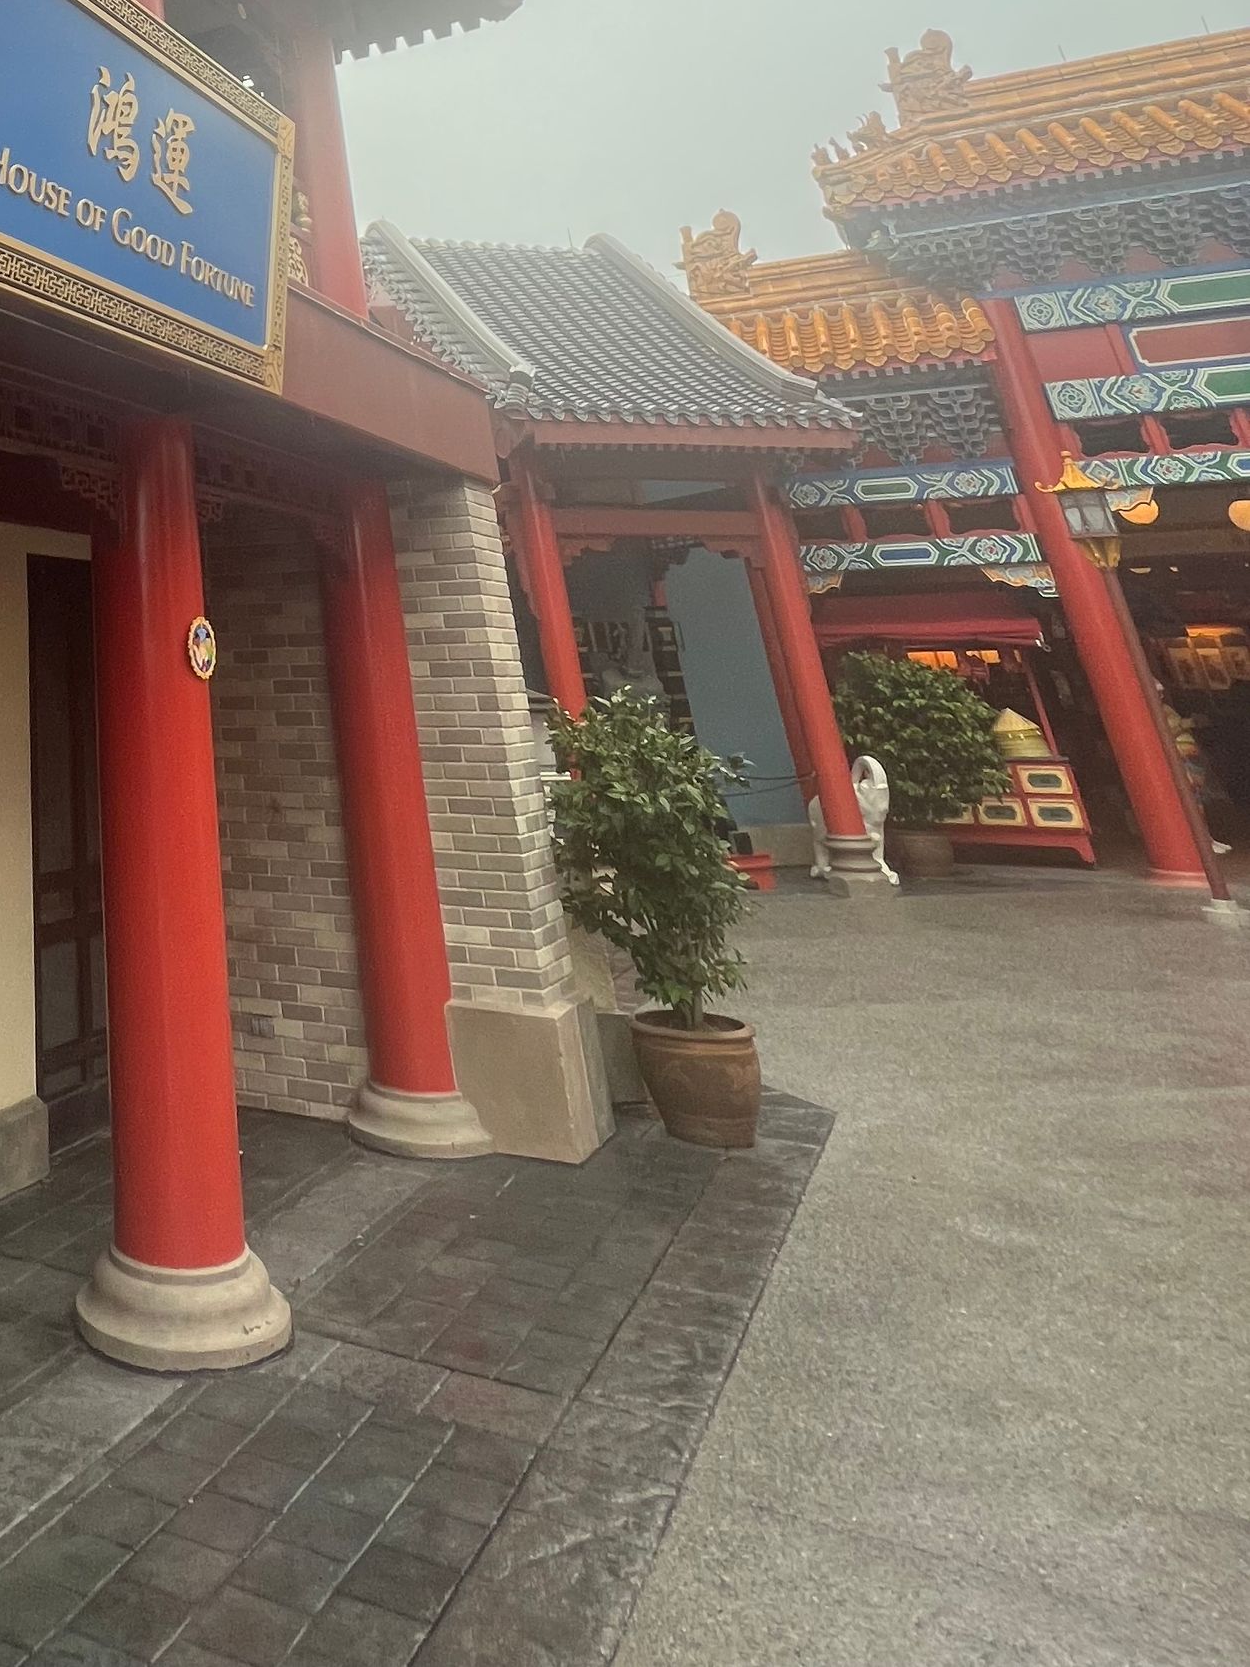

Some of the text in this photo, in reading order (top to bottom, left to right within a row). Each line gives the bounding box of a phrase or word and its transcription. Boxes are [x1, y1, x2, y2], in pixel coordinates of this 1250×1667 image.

[87, 66, 195, 215] 鴻運
[76, 198, 108, 231] OF
[111, 207, 176, 267] GOOD
[180, 240, 256, 308] FORTUNE
